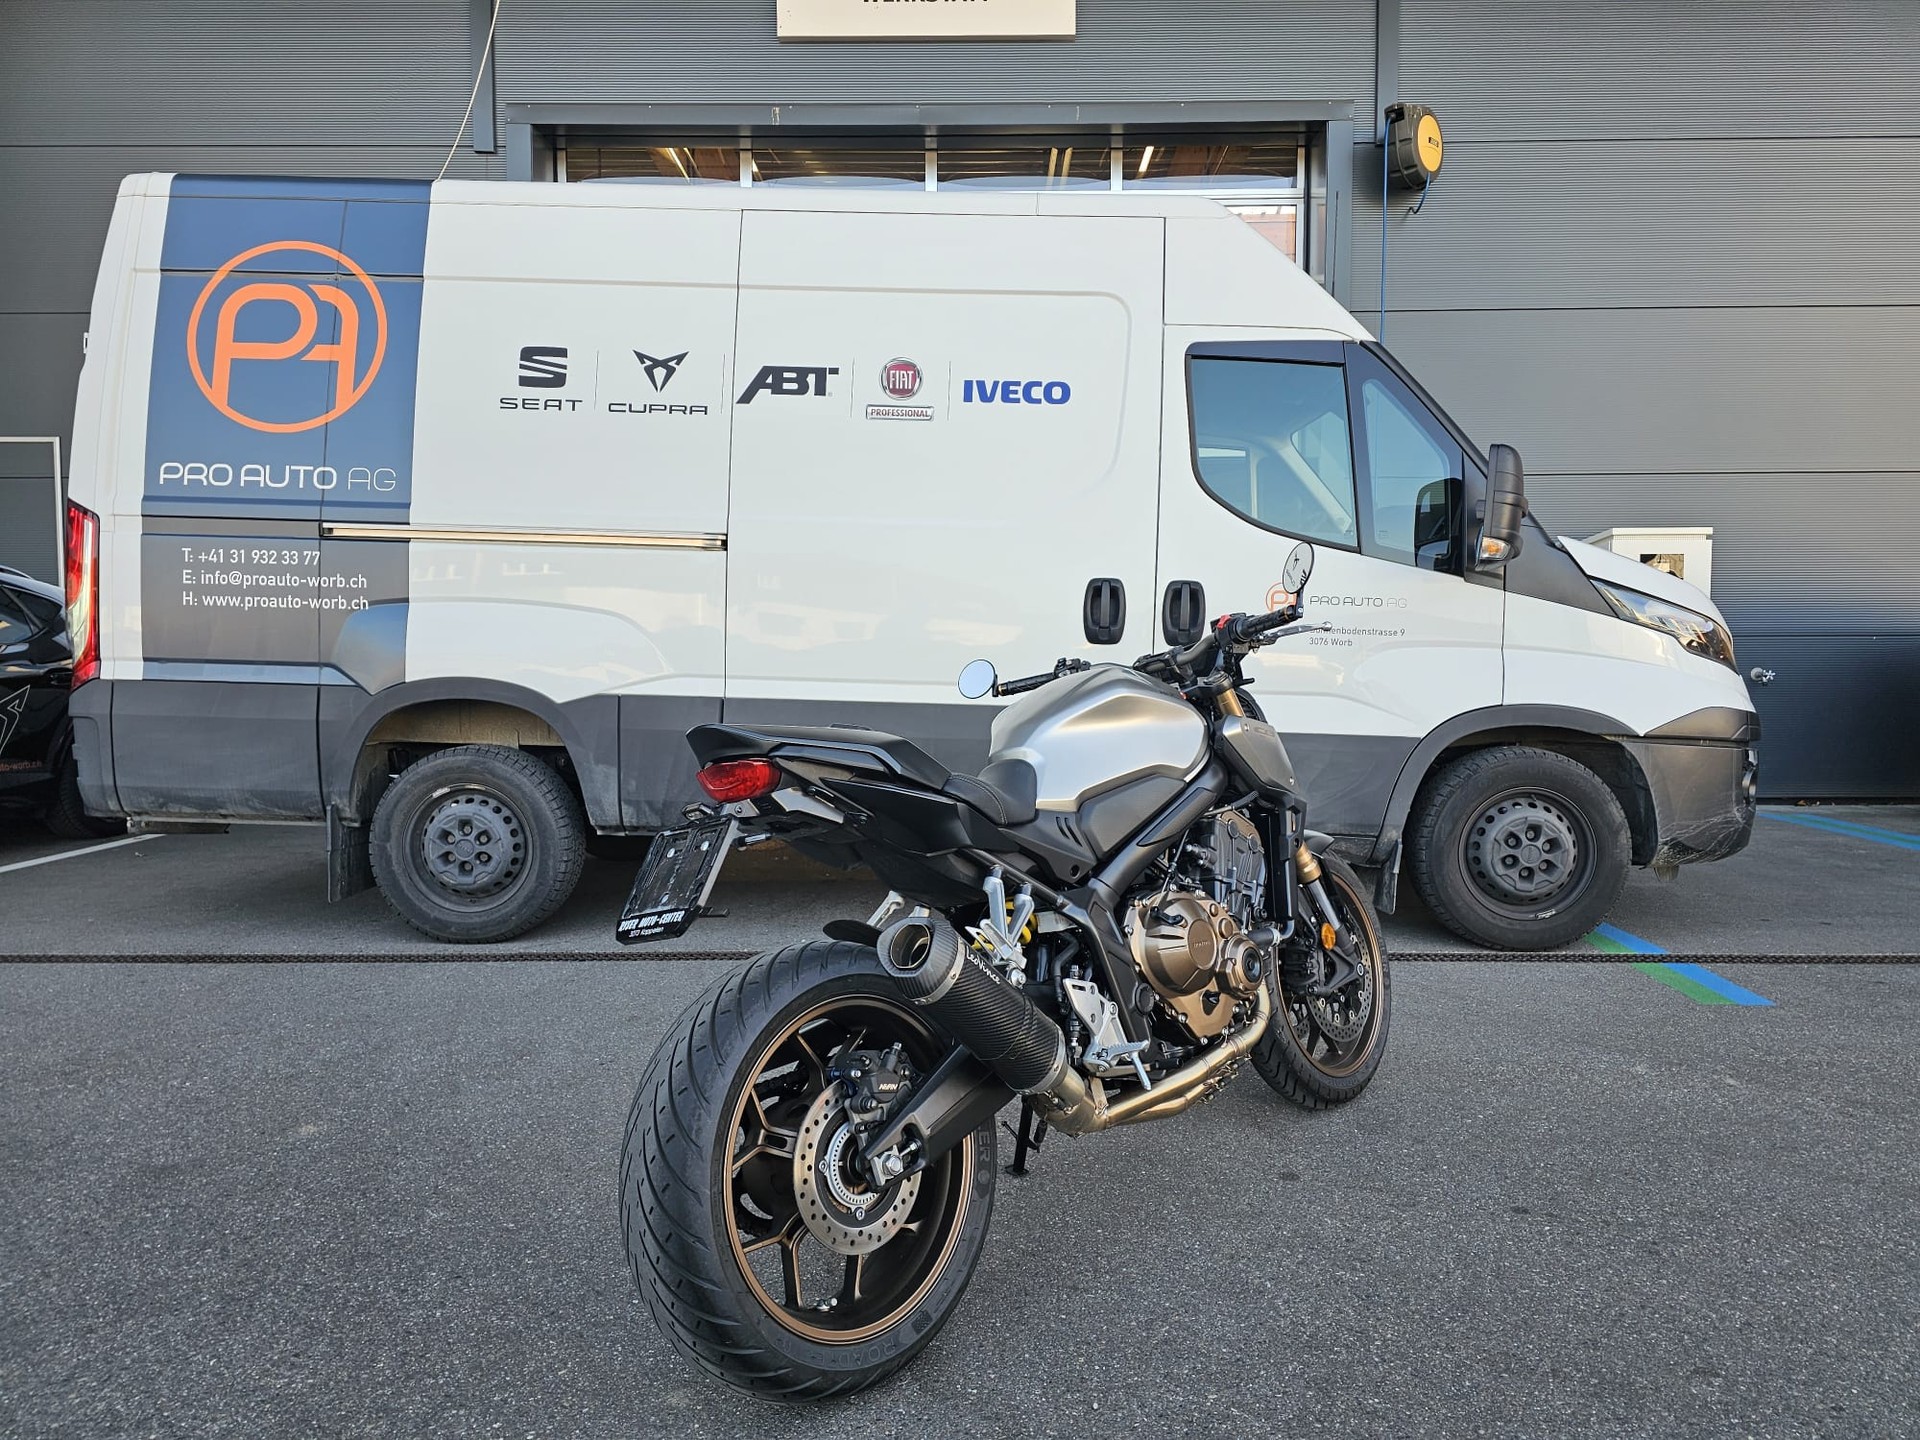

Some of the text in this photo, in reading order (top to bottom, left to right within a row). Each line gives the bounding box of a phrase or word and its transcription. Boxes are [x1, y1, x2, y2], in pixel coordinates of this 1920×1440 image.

[735, 365, 840, 405] ABT
[889, 369, 915, 390] FIAT
[962, 379, 1071, 405] IVECO
[499, 397, 583, 412] SEAT
[608, 402, 708, 416] CUPRA
[870, 408, 931, 418] PROFESSIONAL
[159, 462, 397, 492] PRO AUTO AG
[181, 547, 321, 566] T: +41 31 932 33 77
[182, 569, 368, 589] E: info@proauto-worb.ch
[182, 591, 369, 611] H: www.proauto-worb.ch
[1309, 595, 1408, 609] PRO AUTO AG
[1309, 636, 1353, 647] 3076 Worb
[1400, 628, 1406, 637] 9
